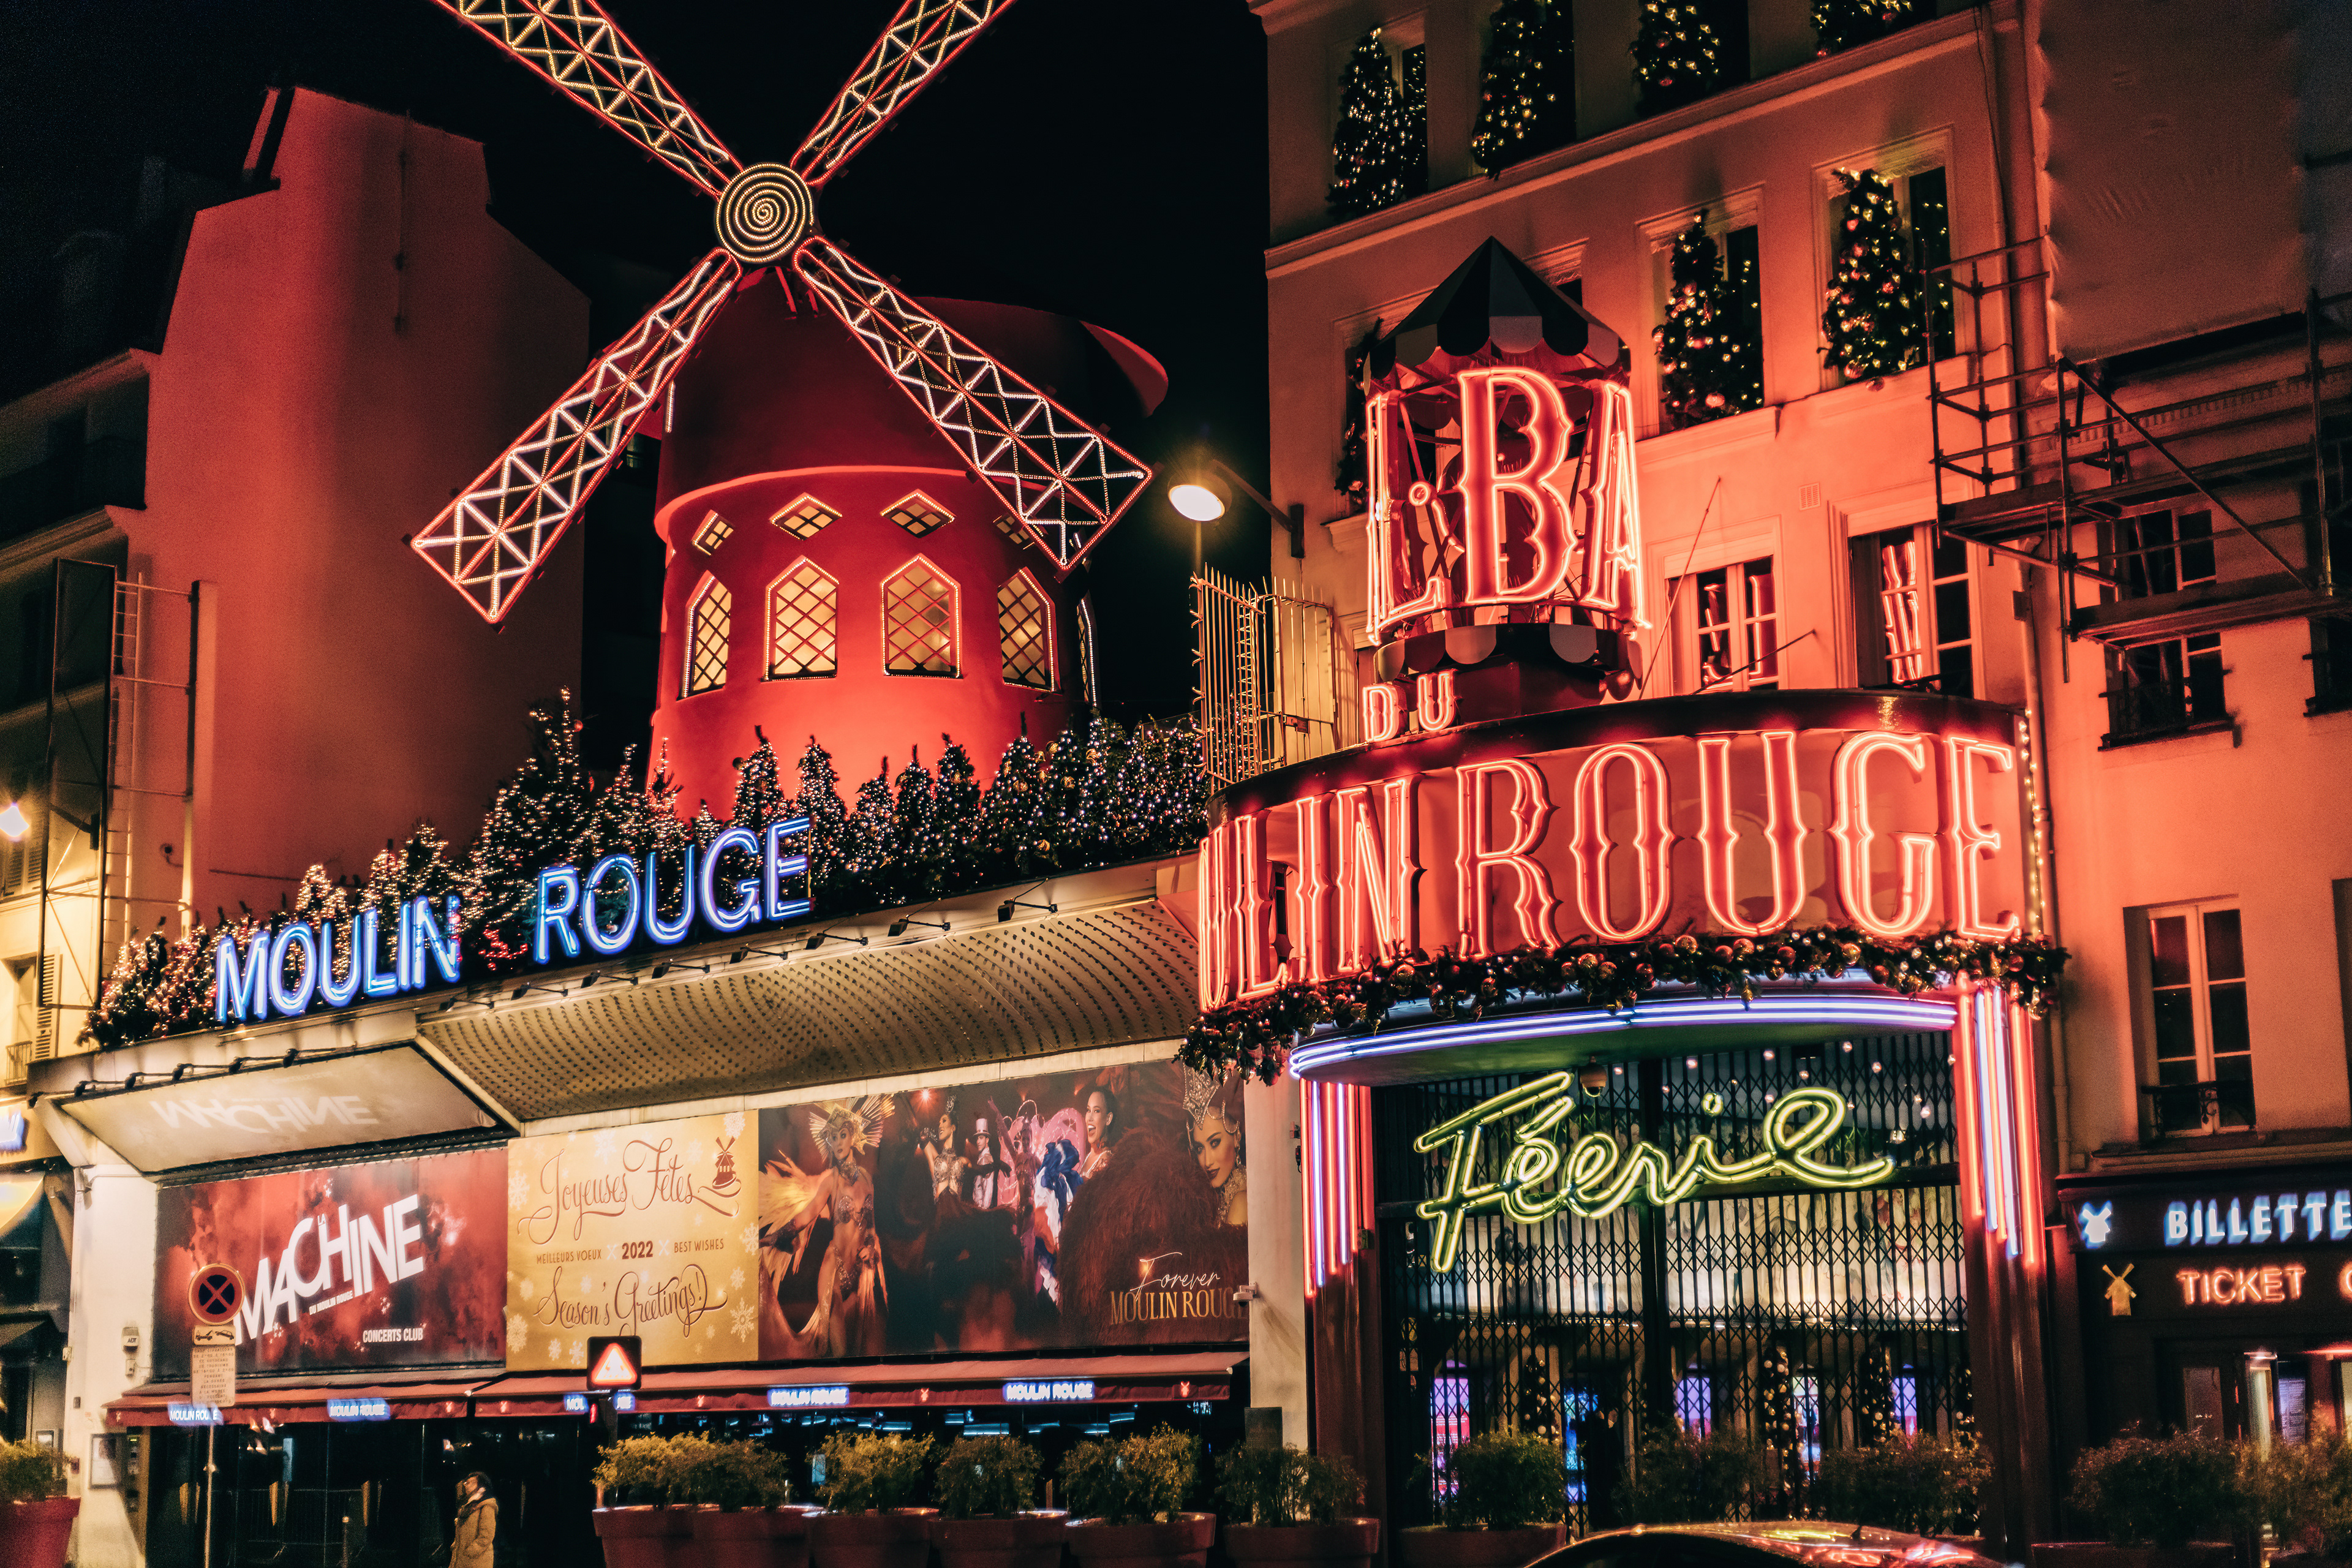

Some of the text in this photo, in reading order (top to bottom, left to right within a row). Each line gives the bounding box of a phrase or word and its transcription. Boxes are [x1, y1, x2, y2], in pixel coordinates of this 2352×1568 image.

[1363, 669, 1457, 742] DU
[1454, 731, 2020, 960] ROUGE
[214, 815, 816, 1023] MOULIN ROUGE
[517, 1137, 739, 1245] Joyeuses Fêtes
[1412, 1071, 1895, 1274] Féerie
[317, 1213, 326, 1226] LA
[622, 1240, 654, 1260] 2022
[674, 1240, 692, 1253] BEST
[694, 1238, 724, 1251] WISHES
[233, 1194, 425, 1346] MACHINE
[1129, 1251, 1220, 1302] Forever
[2175, 1265, 2307, 1306] TICKET
[309, 1290, 353, 1315] DU MOULIN ROUGE
[533, 1264, 728, 1338] Season's Greetings!
[1110, 1290, 1177, 1324] MOULIN
[363, 1327, 424, 1343] CONCERTS CLUB
[771, 1389, 812, 1406] MOULIN
[1006, 1382, 1093, 1400] MOULIN ROUGE
[170, 1408, 217, 1421] MOULIN ROUE
[330, 1404, 360, 1417] MOULIN
